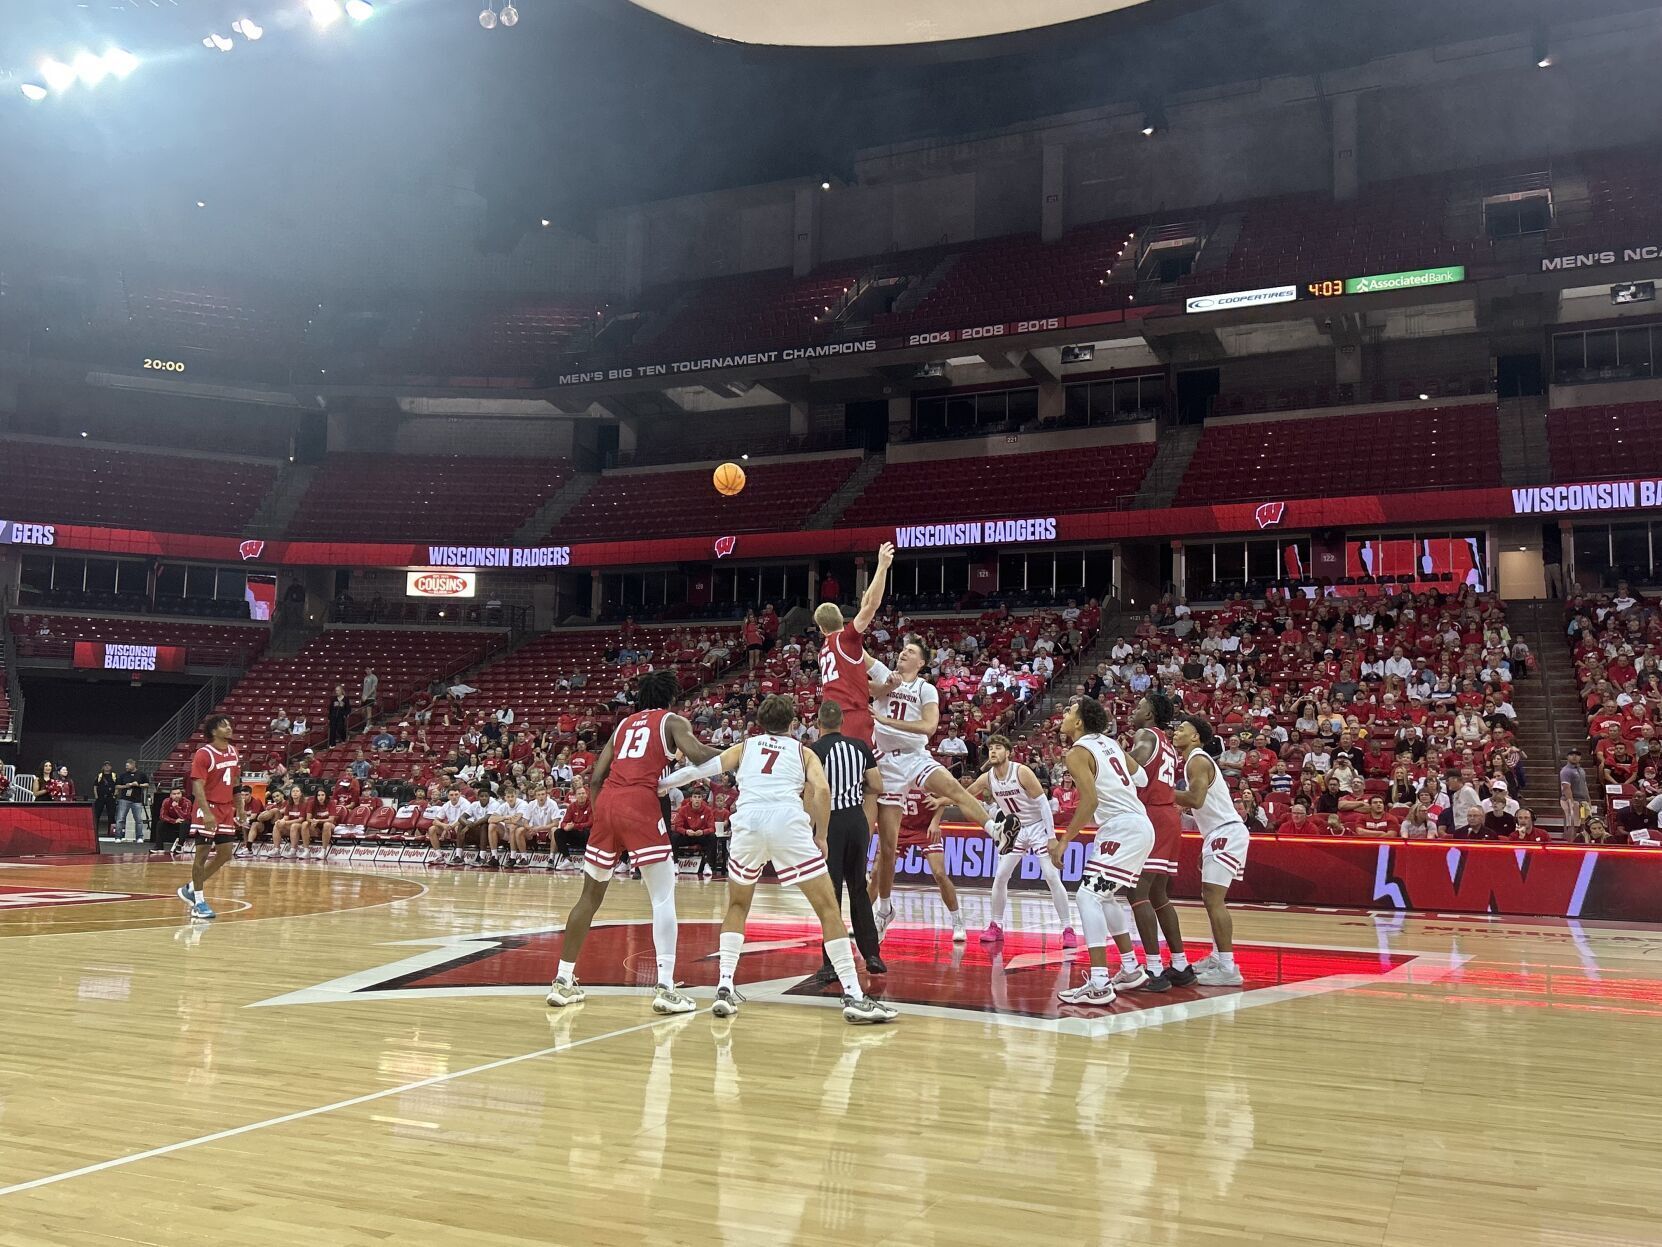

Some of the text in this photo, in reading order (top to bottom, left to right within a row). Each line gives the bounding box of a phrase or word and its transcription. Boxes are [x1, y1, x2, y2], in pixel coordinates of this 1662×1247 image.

[1542, 246, 1662, 270] MEN'S NC
[1308, 280, 1342, 301] 4:03
[909, 318, 1059, 345] 2004 2008 2015
[143, 358, 185, 372] 20:00
[559, 340, 877, 384] MEN'S BIG TEN TOURNAMENT CHAMPIONS
[1512, 482, 1635, 513] WISCONSIN
[12, 524, 54, 546] GERS
[896, 518, 1056, 548] WISCONSIN BADGERS
[429, 546, 570, 567] WISCONSIN BADGERS
[419, 577, 464, 591] COUSINS
[105, 644, 157, 657] WISCONSIN
[104, 655, 156, 671] BADGERS
[820, 652, 840, 685] 22
[887, 700, 908, 721] 31
[617, 726, 651, 760] 13
[761, 747, 780, 775] 7
[1109, 756, 1130, 787] 9
[1157, 751, 1175, 788] 25
[222, 767, 231, 786] 4
[1003, 798, 1021, 814] 11
